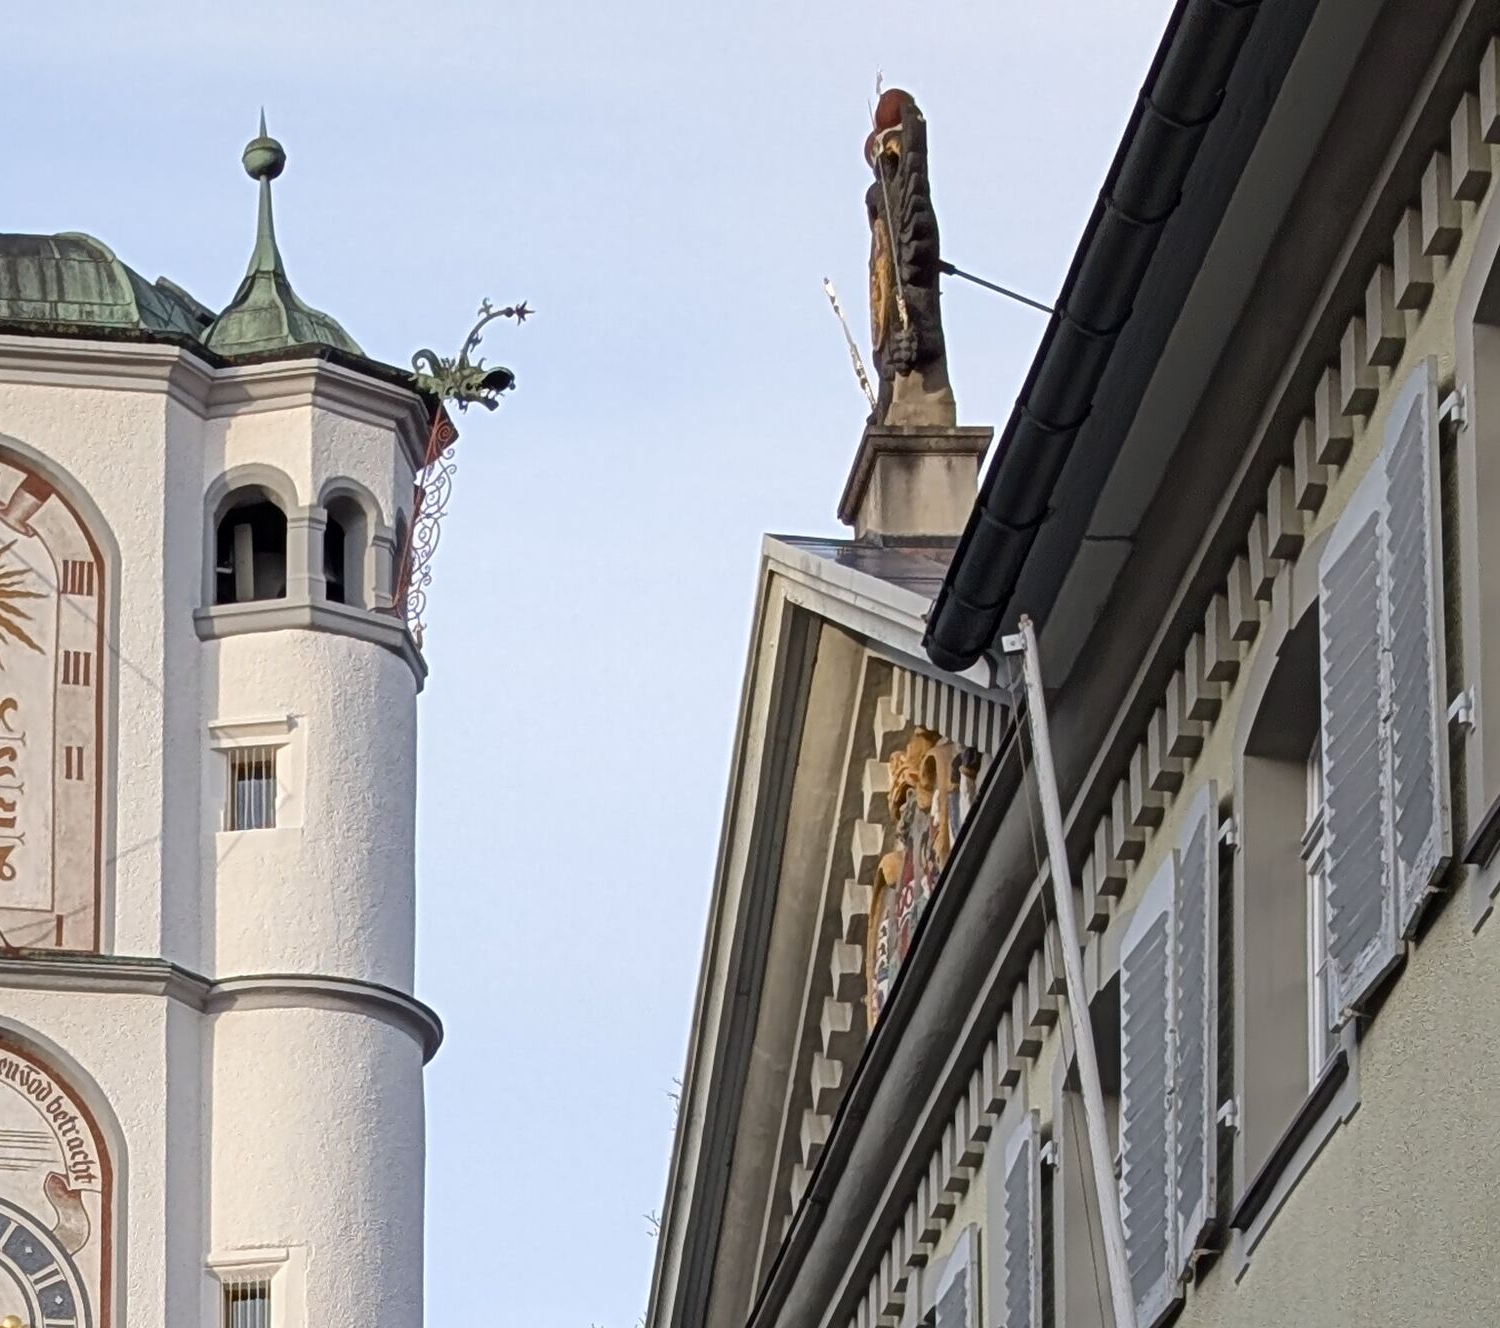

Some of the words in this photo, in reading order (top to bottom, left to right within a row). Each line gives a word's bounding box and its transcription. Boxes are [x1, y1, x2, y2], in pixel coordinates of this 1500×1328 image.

[61, 559, 95, 596] IIII
[61, 649, 92, 687] III
[64, 745, 84, 781] II
[19, 1064, 53, 1102] Tod
[26, 1262, 66, 1294] II
